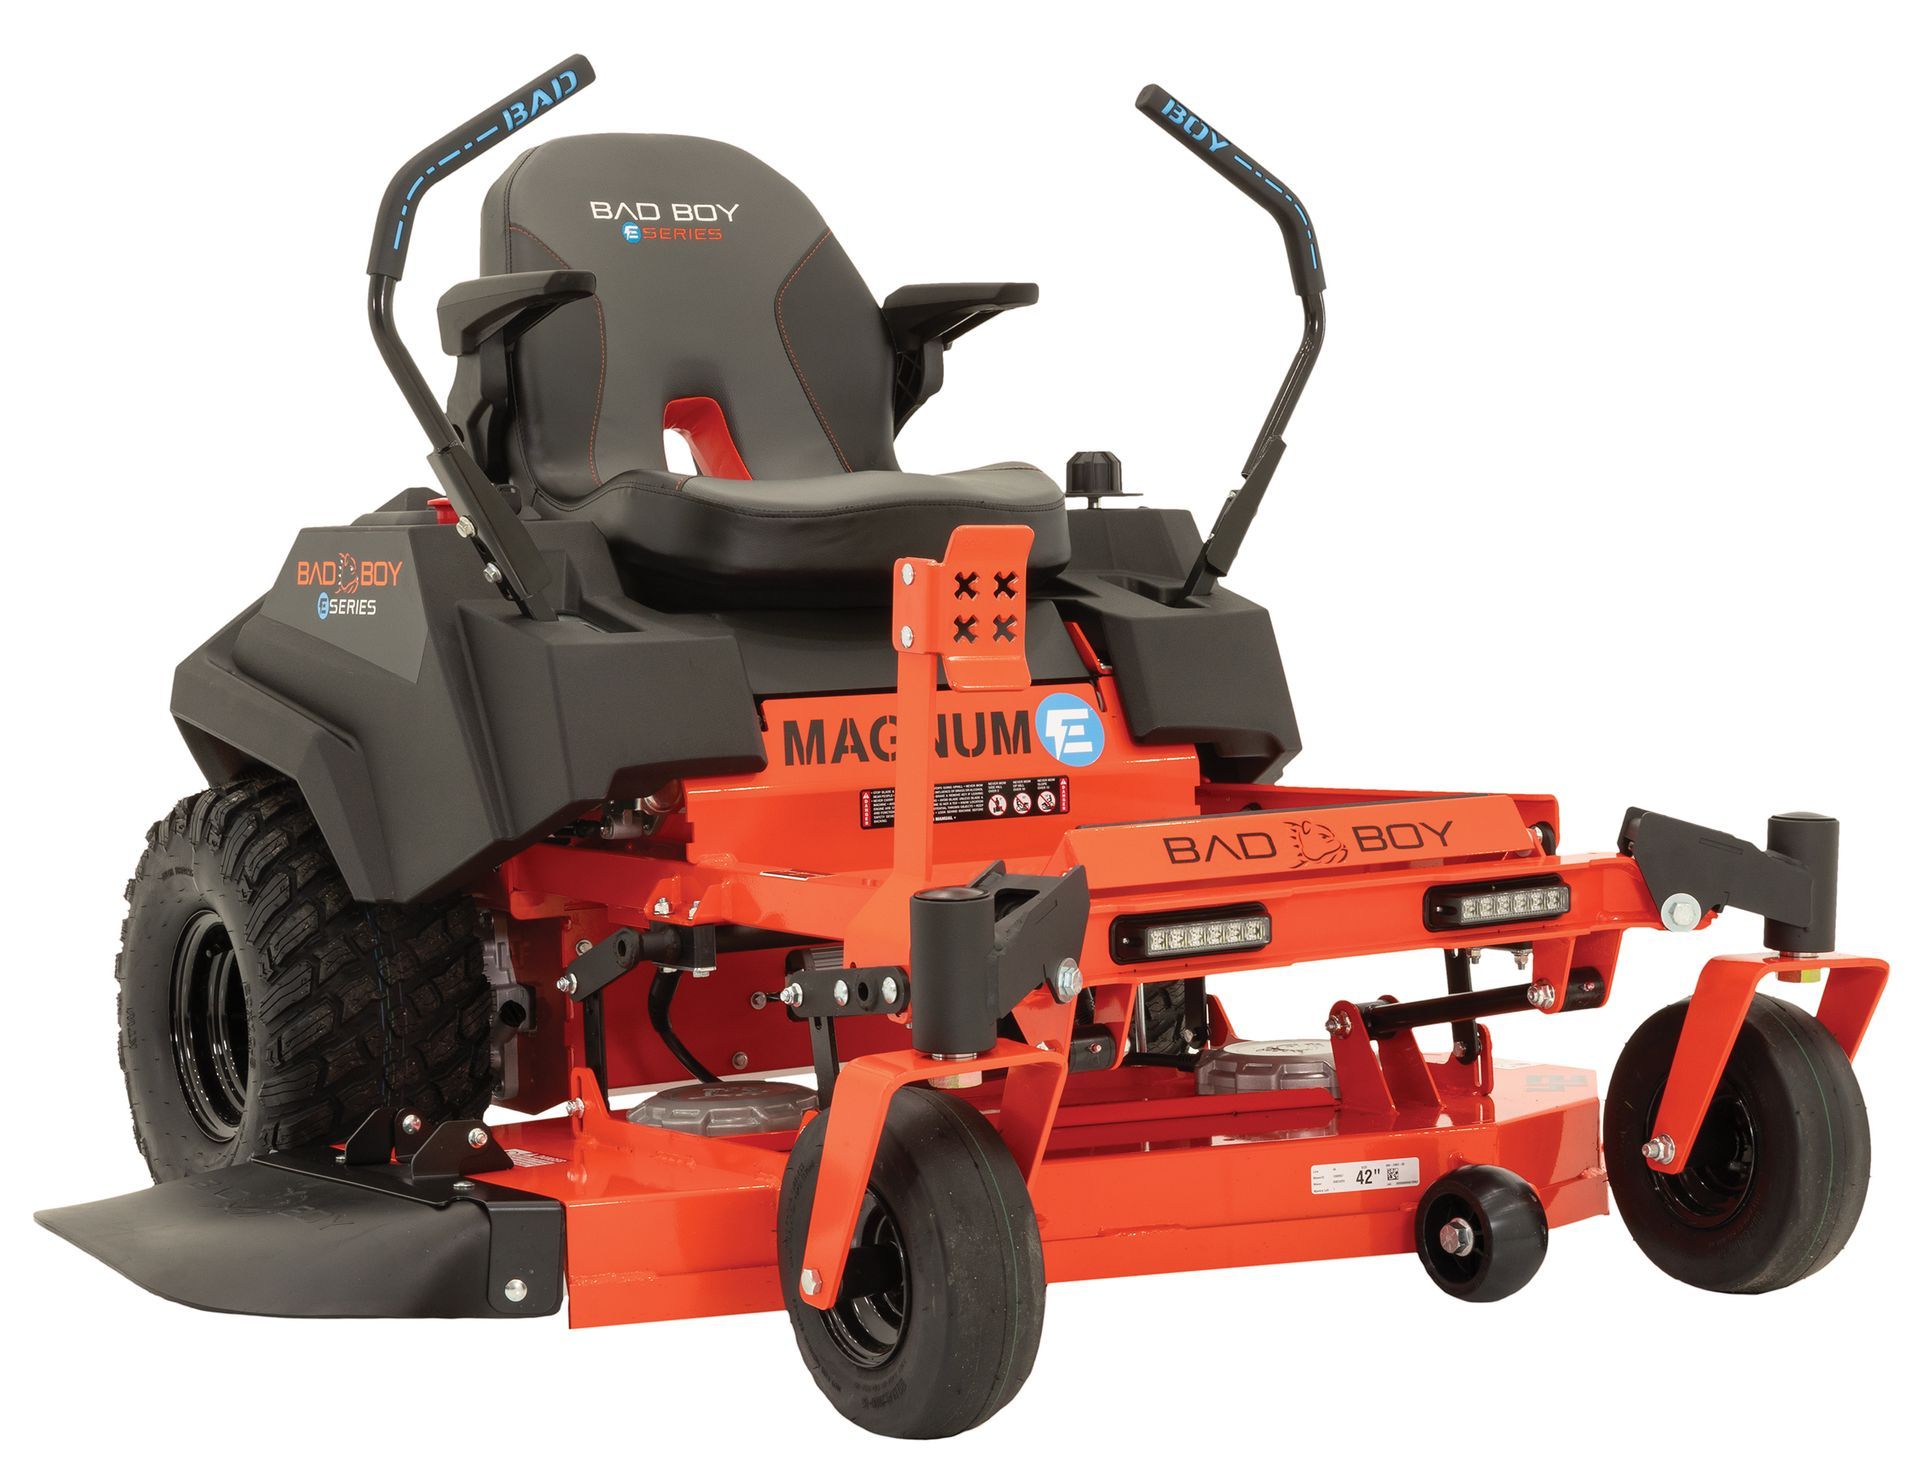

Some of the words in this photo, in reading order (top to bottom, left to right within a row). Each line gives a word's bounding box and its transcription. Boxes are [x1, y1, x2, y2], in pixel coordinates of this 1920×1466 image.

[502, 69, 578, 132] BAD
[1161, 98, 1230, 152] BOY
[590, 201, 661, 221] BAD
[671, 203, 740, 223] BOY
[641, 227, 723, 241] SERIES
[297, 561, 337, 586] BAD
[360, 560, 403, 587] BOY
[329, 599, 377, 616] SERIES
[1162, 832, 1278, 865] BAD
[1352, 820, 1453, 852] BOY
[1356, 1168, 1380, 1185] 42"
